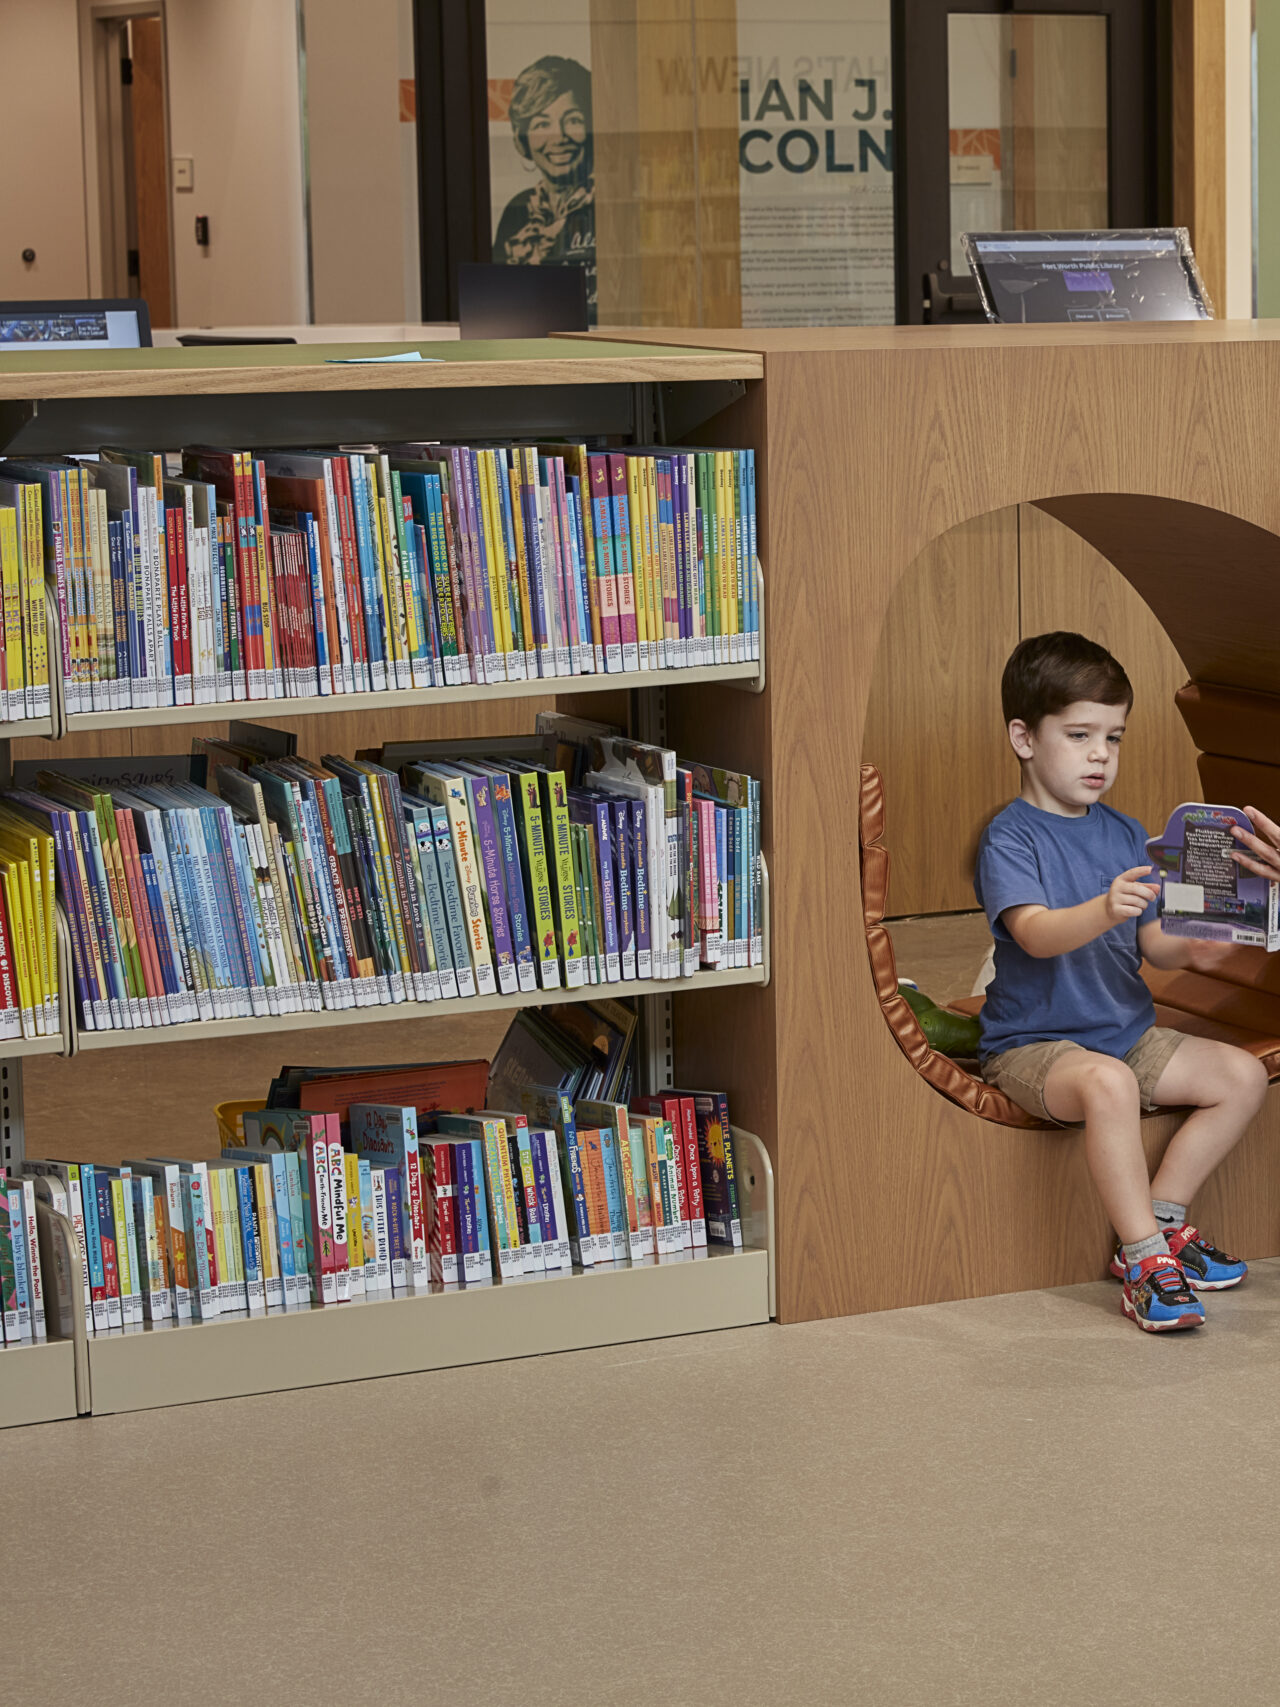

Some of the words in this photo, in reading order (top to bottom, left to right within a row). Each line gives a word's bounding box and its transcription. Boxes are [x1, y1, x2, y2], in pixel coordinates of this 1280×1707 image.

[739, 129, 893, 173] COLN
[429, 512, 437, 526] THE
[599, 496, 608, 520] LLAMA
[430, 527, 438, 539] BIG
[600, 521, 609, 545] LLAMA
[54, 536, 63, 562] PARKER
[431, 539, 440, 561] BOOK
[601, 545, 611, 578] 5-MINUTE
[56, 563, 64, 587] SHINES
[434, 563, 441, 572] OF
[57, 588, 65, 599] ON
[144, 565, 152, 610] BONAPARTE
[219, 565, 227, 601] GOODNIGHT
[228, 578, 236, 610] GOODNIGHT
[489, 575, 499, 611] patchwork
[605, 578, 614, 607] STORIES
[171, 597, 179, 613] Little
[403, 582, 414, 620] dinosaur
[436, 576, 448, 638] SUPERPOWERS
[582, 595, 590, 614] BOAT
[146, 612, 154, 636] FALLS
[221, 602, 230, 653] BASKETBALL
[229, 612, 237, 640] FOOTBALL
[147, 639, 155, 663] APART
[617, 810, 626, 830] Disney
[455, 820, 469, 863] 5-Minute
[503, 826, 515, 862] 5-Minute
[618, 833, 625, 841] my
[328, 855, 339, 886] GRACE
[483, 839, 496, 879] 5-Minute
[530, 815, 544, 856] 5-MINUTE
[537, 885, 551, 921] STORIES
[603, 861, 609, 869] my
[394, 859, 405, 889] Zombie
[405, 862, 415, 893] Zombie
[508, 862, 519, 885] Under
[81, 879, 89, 899] LLAMA
[109, 877, 122, 919] EXCAVATOR
[333, 887, 343, 904] FOR
[399, 890, 407, 899] in
[409, 893, 416, 902] in
[445, 880, 462, 923] Bedtime
[466, 885, 480, 917] Bunnies
[490, 880, 501, 906] Horse
[511, 886, 520, 898] the
[603, 880, 616, 921] Bedtime
[619, 869, 630, 911] Bedtime
[84, 899, 93, 921] LLAMA
[400, 900, 410, 919] Love
[411, 903, 421, 922] Love
[512, 898, 521, 913] Sea
[89, 921, 97, 942] MISSES
[340, 908, 353, 957] PRESIDENT
[471, 919, 483, 951] Stories
[493, 907, 506, 938] Stories
[514, 913, 525, 942] Stories
[607, 921, 615, 947] storybook
[622, 910, 630, 935] storybook
[92, 942, 100, 961] MAMA
[721, 1111, 730, 1139] LITTLE
[486, 1127, 496, 1160] OPTICAL
[498, 1127, 508, 1167] QUANTUM
[688, 1143, 697, 1161] Once
[315, 1145, 326, 1175] ABC
[330, 1148, 342, 1177] ABC
[410, 1162, 417, 1171] 12
[569, 1145, 582, 1174] FRIENDS
[689, 1162, 698, 1180] Upon
[724, 1141, 734, 1180] PLANETS
[409, 1172, 419, 1187] Days
[490, 1161, 500, 1193] PHYSICS
[502, 1167, 513, 1200] PHYSICS
[523, 1166, 532, 1186] Crack
[318, 1174, 326, 1215] Earth-Friendly
[333, 1178, 345, 1221] Mindful
[525, 1186, 536, 1207] Whisk
[691, 1188, 702, 1206] Potty
[28, 1216, 36, 1237] Hello,
[321, 1214, 329, 1226] Me
[412, 1199, 420, 1230] Dinosaurs
[496, 1204, 504, 1225] babies
[528, 1207, 537, 1224] Bake
[336, 1223, 345, 1241] Me
[14, 1234, 24, 1261] baby's
[29, 1238, 38, 1264] Winnie
[16, 1262, 26, 1294] blanket
[31, 1265, 39, 1277] the
[33, 1278, 42, 1299] Pooh!
